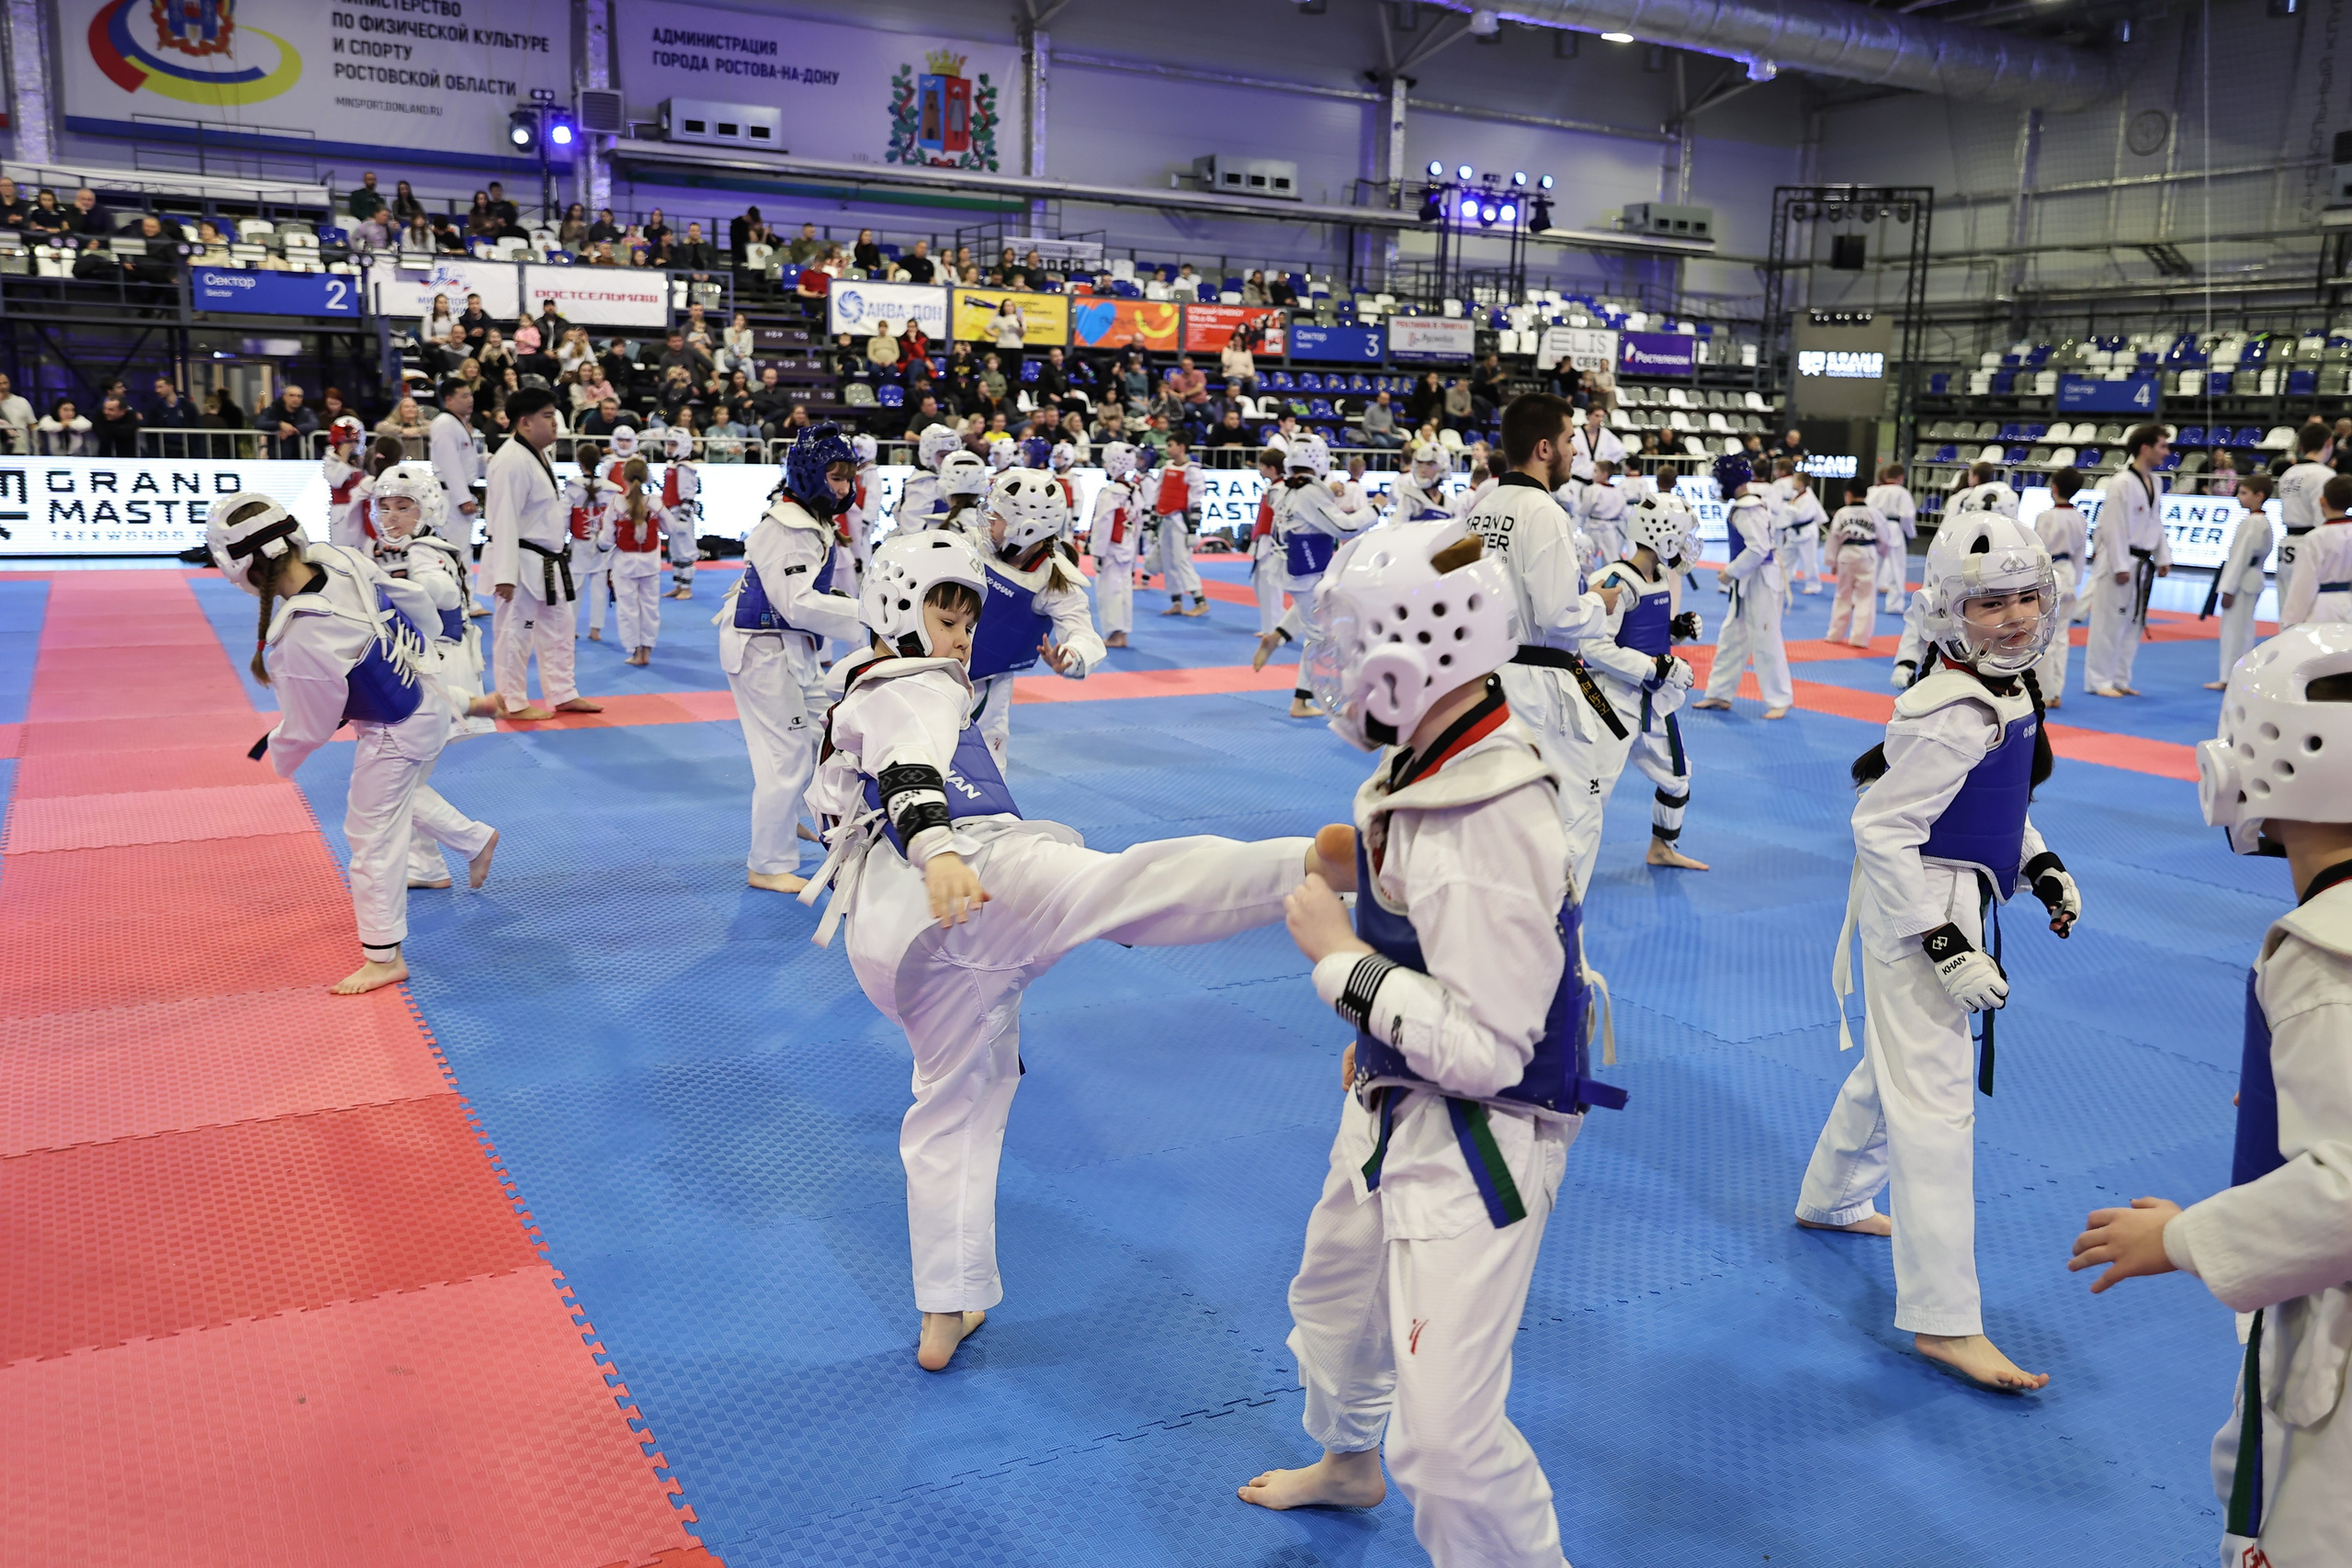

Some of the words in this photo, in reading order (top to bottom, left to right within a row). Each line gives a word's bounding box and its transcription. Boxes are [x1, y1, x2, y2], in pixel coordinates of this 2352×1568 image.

[336, 0, 461, 17] СТЕРСТВО
[333, 12, 355, 29] ПО
[359, 15, 469, 43] ФИЗИЧЕСКОЙ
[473, 29, 549, 53] КУЛЬТУРЕ
[653, 28, 777, 56] АДМИНИСТРАЦИЯ
[334, 38, 345, 53] И
[351, 39, 413, 62] СПОРТУ
[334, 62, 441, 89] РОСТОВСКОЙ
[446, 75, 516, 96] ОБЛАСТИ
[653, 51, 709, 73] ГОРОДА
[716, 57, 840, 85] РОСТОВА-НА-ДОНУ
[203, 273, 256, 290] Сектор
[325, 279, 348, 310] 2
[418, 296, 469, 307] МИПОР
[866, 302, 943, 321] АКВА-ДОН
[1364, 333, 1380, 357] 3
[1550, 331, 1607, 354] ELIS
[2133, 383, 2152, 408] 4
[46, 469, 242, 494] GRAND
[1204, 480, 1263, 497] RAN
[49, 499, 210, 525] MASTE
[1206, 502, 1261, 520] AST
[2165, 505, 2230, 523] AND
[1477, 533, 1509, 552] TER
[2175, 525, 2222, 545] TER
[945, 770, 982, 800] AN
[1941, 954, 1967, 976] KHAN
